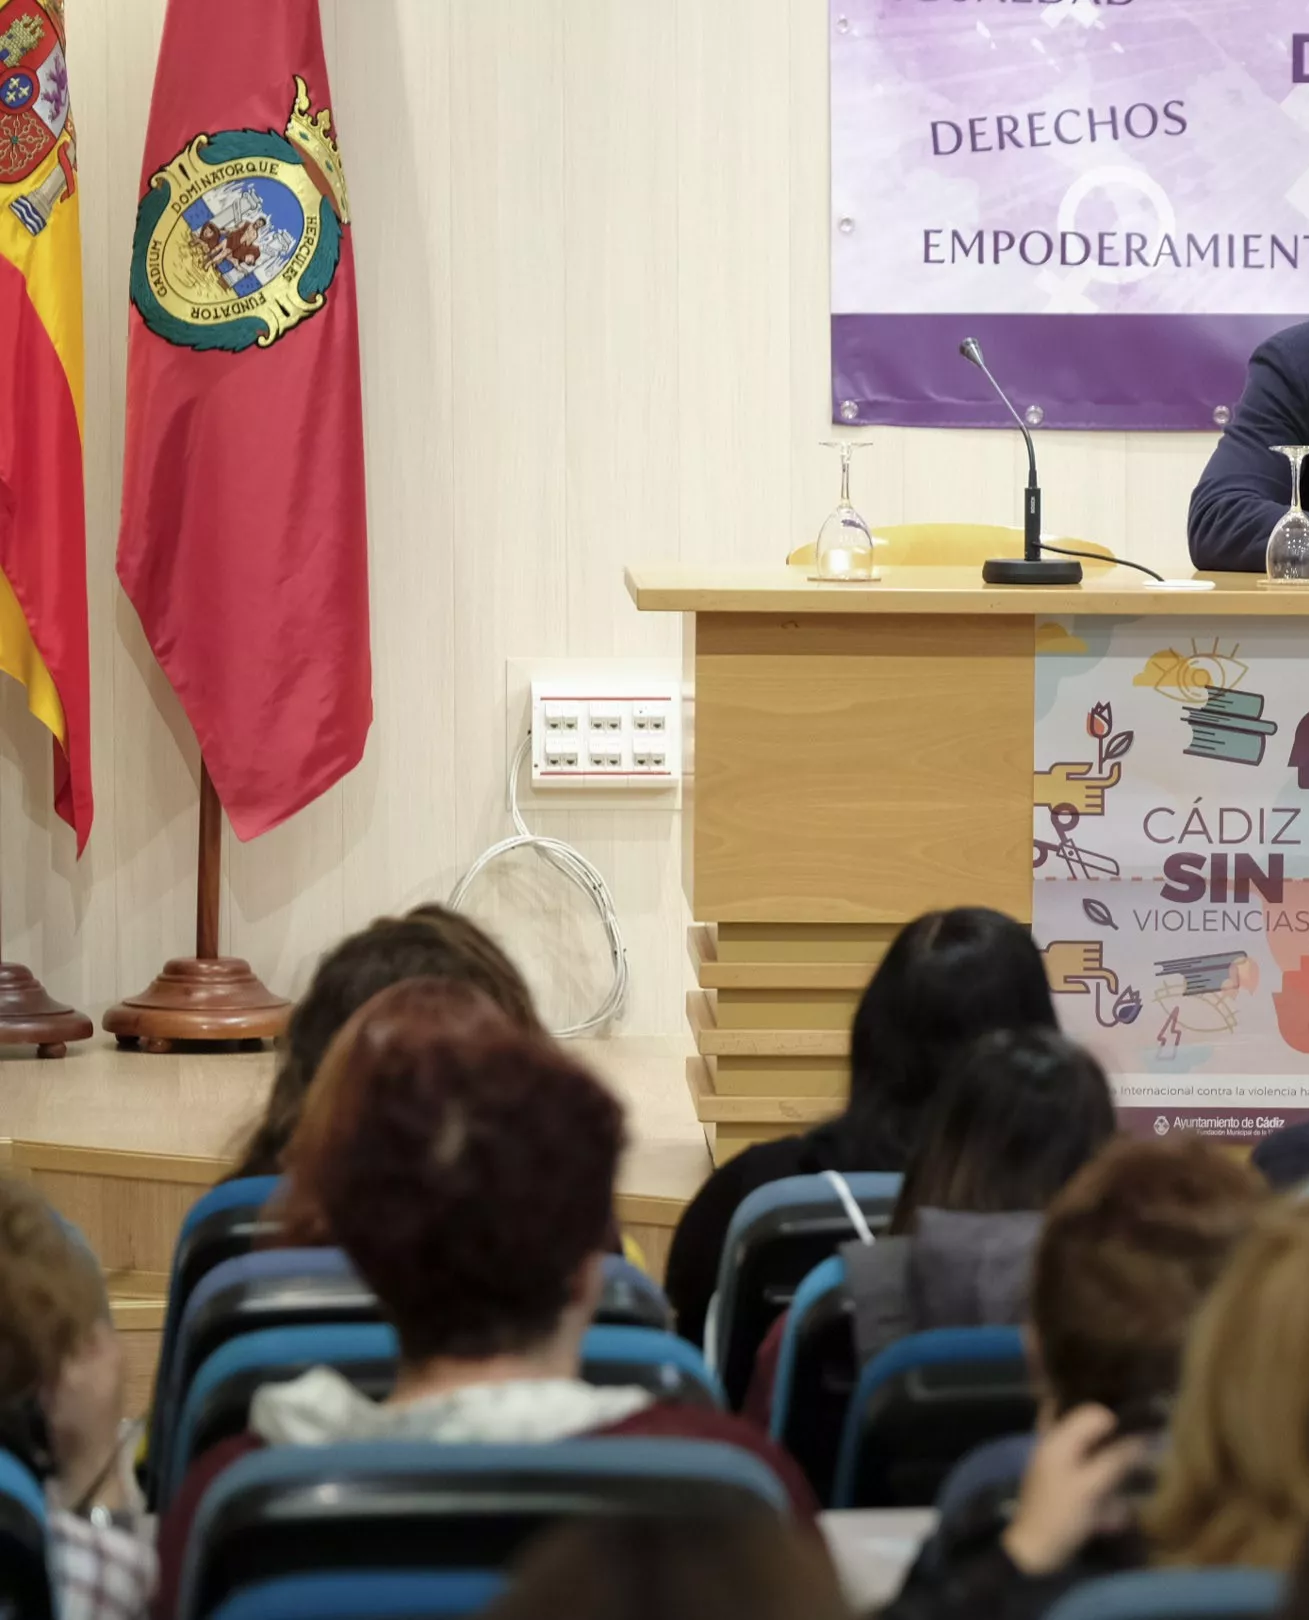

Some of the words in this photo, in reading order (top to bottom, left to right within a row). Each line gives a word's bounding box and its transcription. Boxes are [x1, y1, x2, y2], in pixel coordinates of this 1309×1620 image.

[930, 100, 1187, 156] DERECHOS
[171, 160, 280, 215] DOMINATORQUE
[150, 240, 168, 298] GADIUM
[282, 216, 318, 283] HERCULES
[190, 292, 267, 320] FUNDATOR
[1143, 797, 1301, 844] CÁDIZ
[1160, 852, 1284, 903] SIN
[1133, 909, 1309, 932] VIOLENCIAS
[1120, 1086, 1194, 1096] Internacional
[1197, 1087, 1233, 1096] contra
[1235, 1086, 1246, 1096] la
[1248, 1086, 1297, 1097] violencia
[1173, 1116, 1240, 1129] Ayuntamiento
[1241, 1116, 1254, 1128] de
[1256, 1116, 1285, 1128] Cádiz
